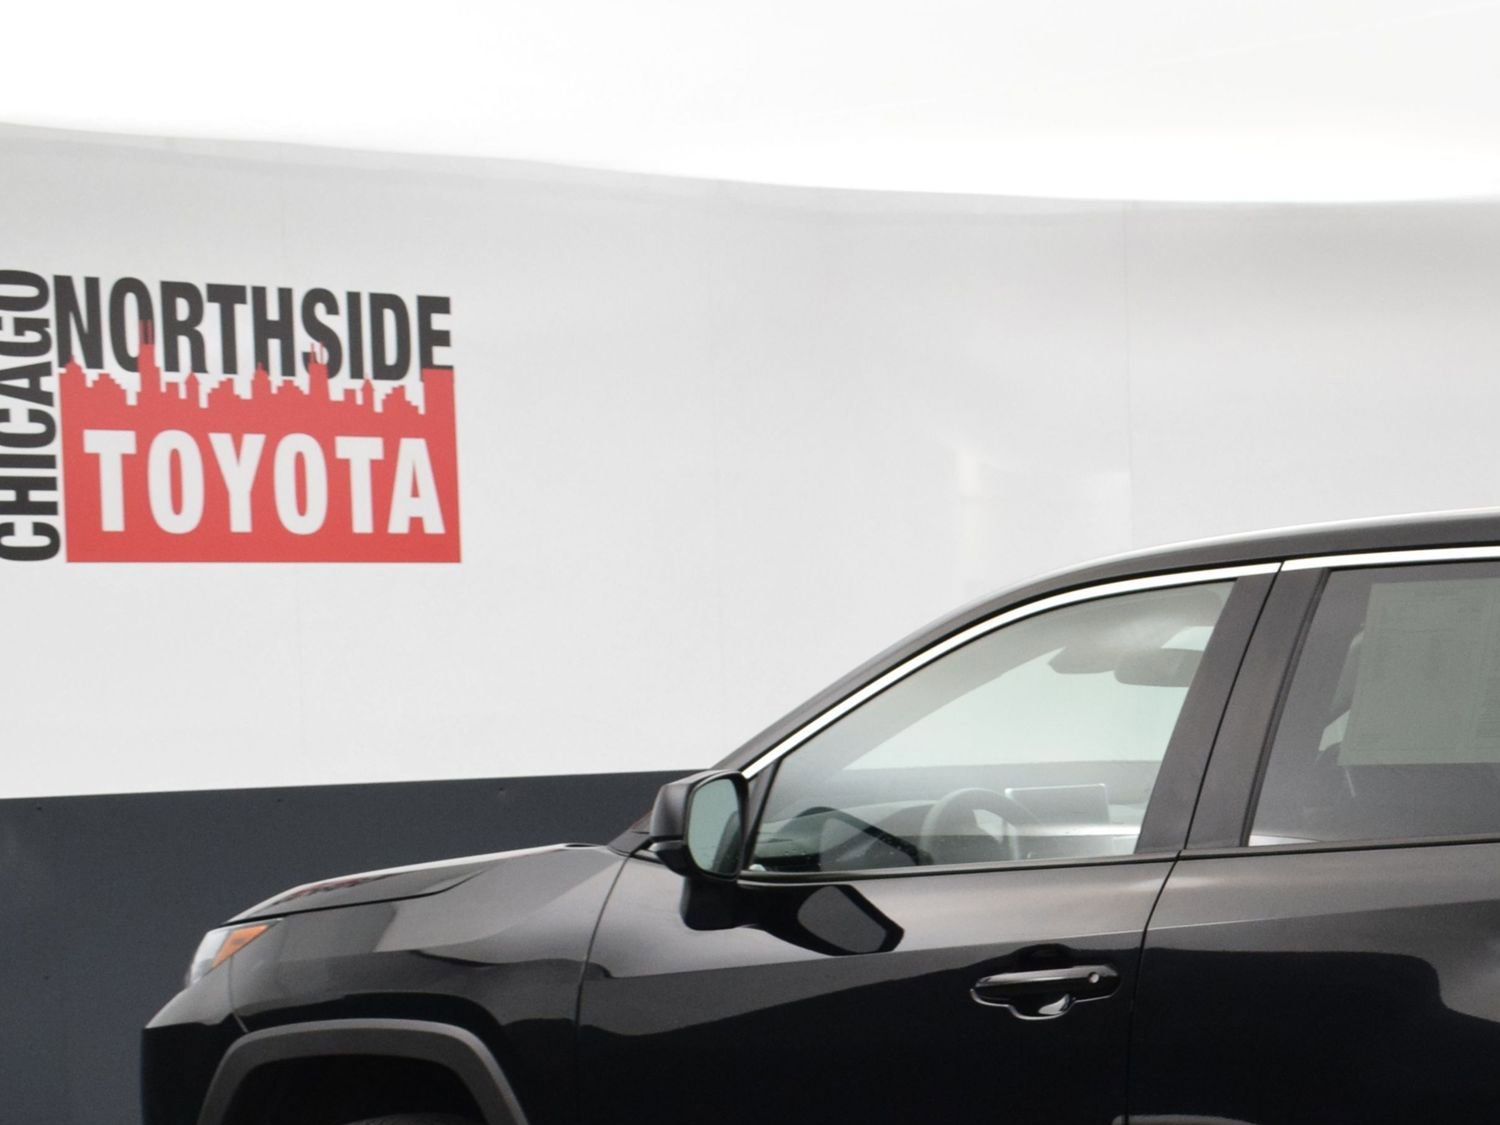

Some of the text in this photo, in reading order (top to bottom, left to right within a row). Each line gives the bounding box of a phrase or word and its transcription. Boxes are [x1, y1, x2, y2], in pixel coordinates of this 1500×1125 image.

[53, 274, 454, 381] NORTHSIDE
[0, 269, 61, 561] CHICAGO
[83, 428, 446, 535] TOYOTA
